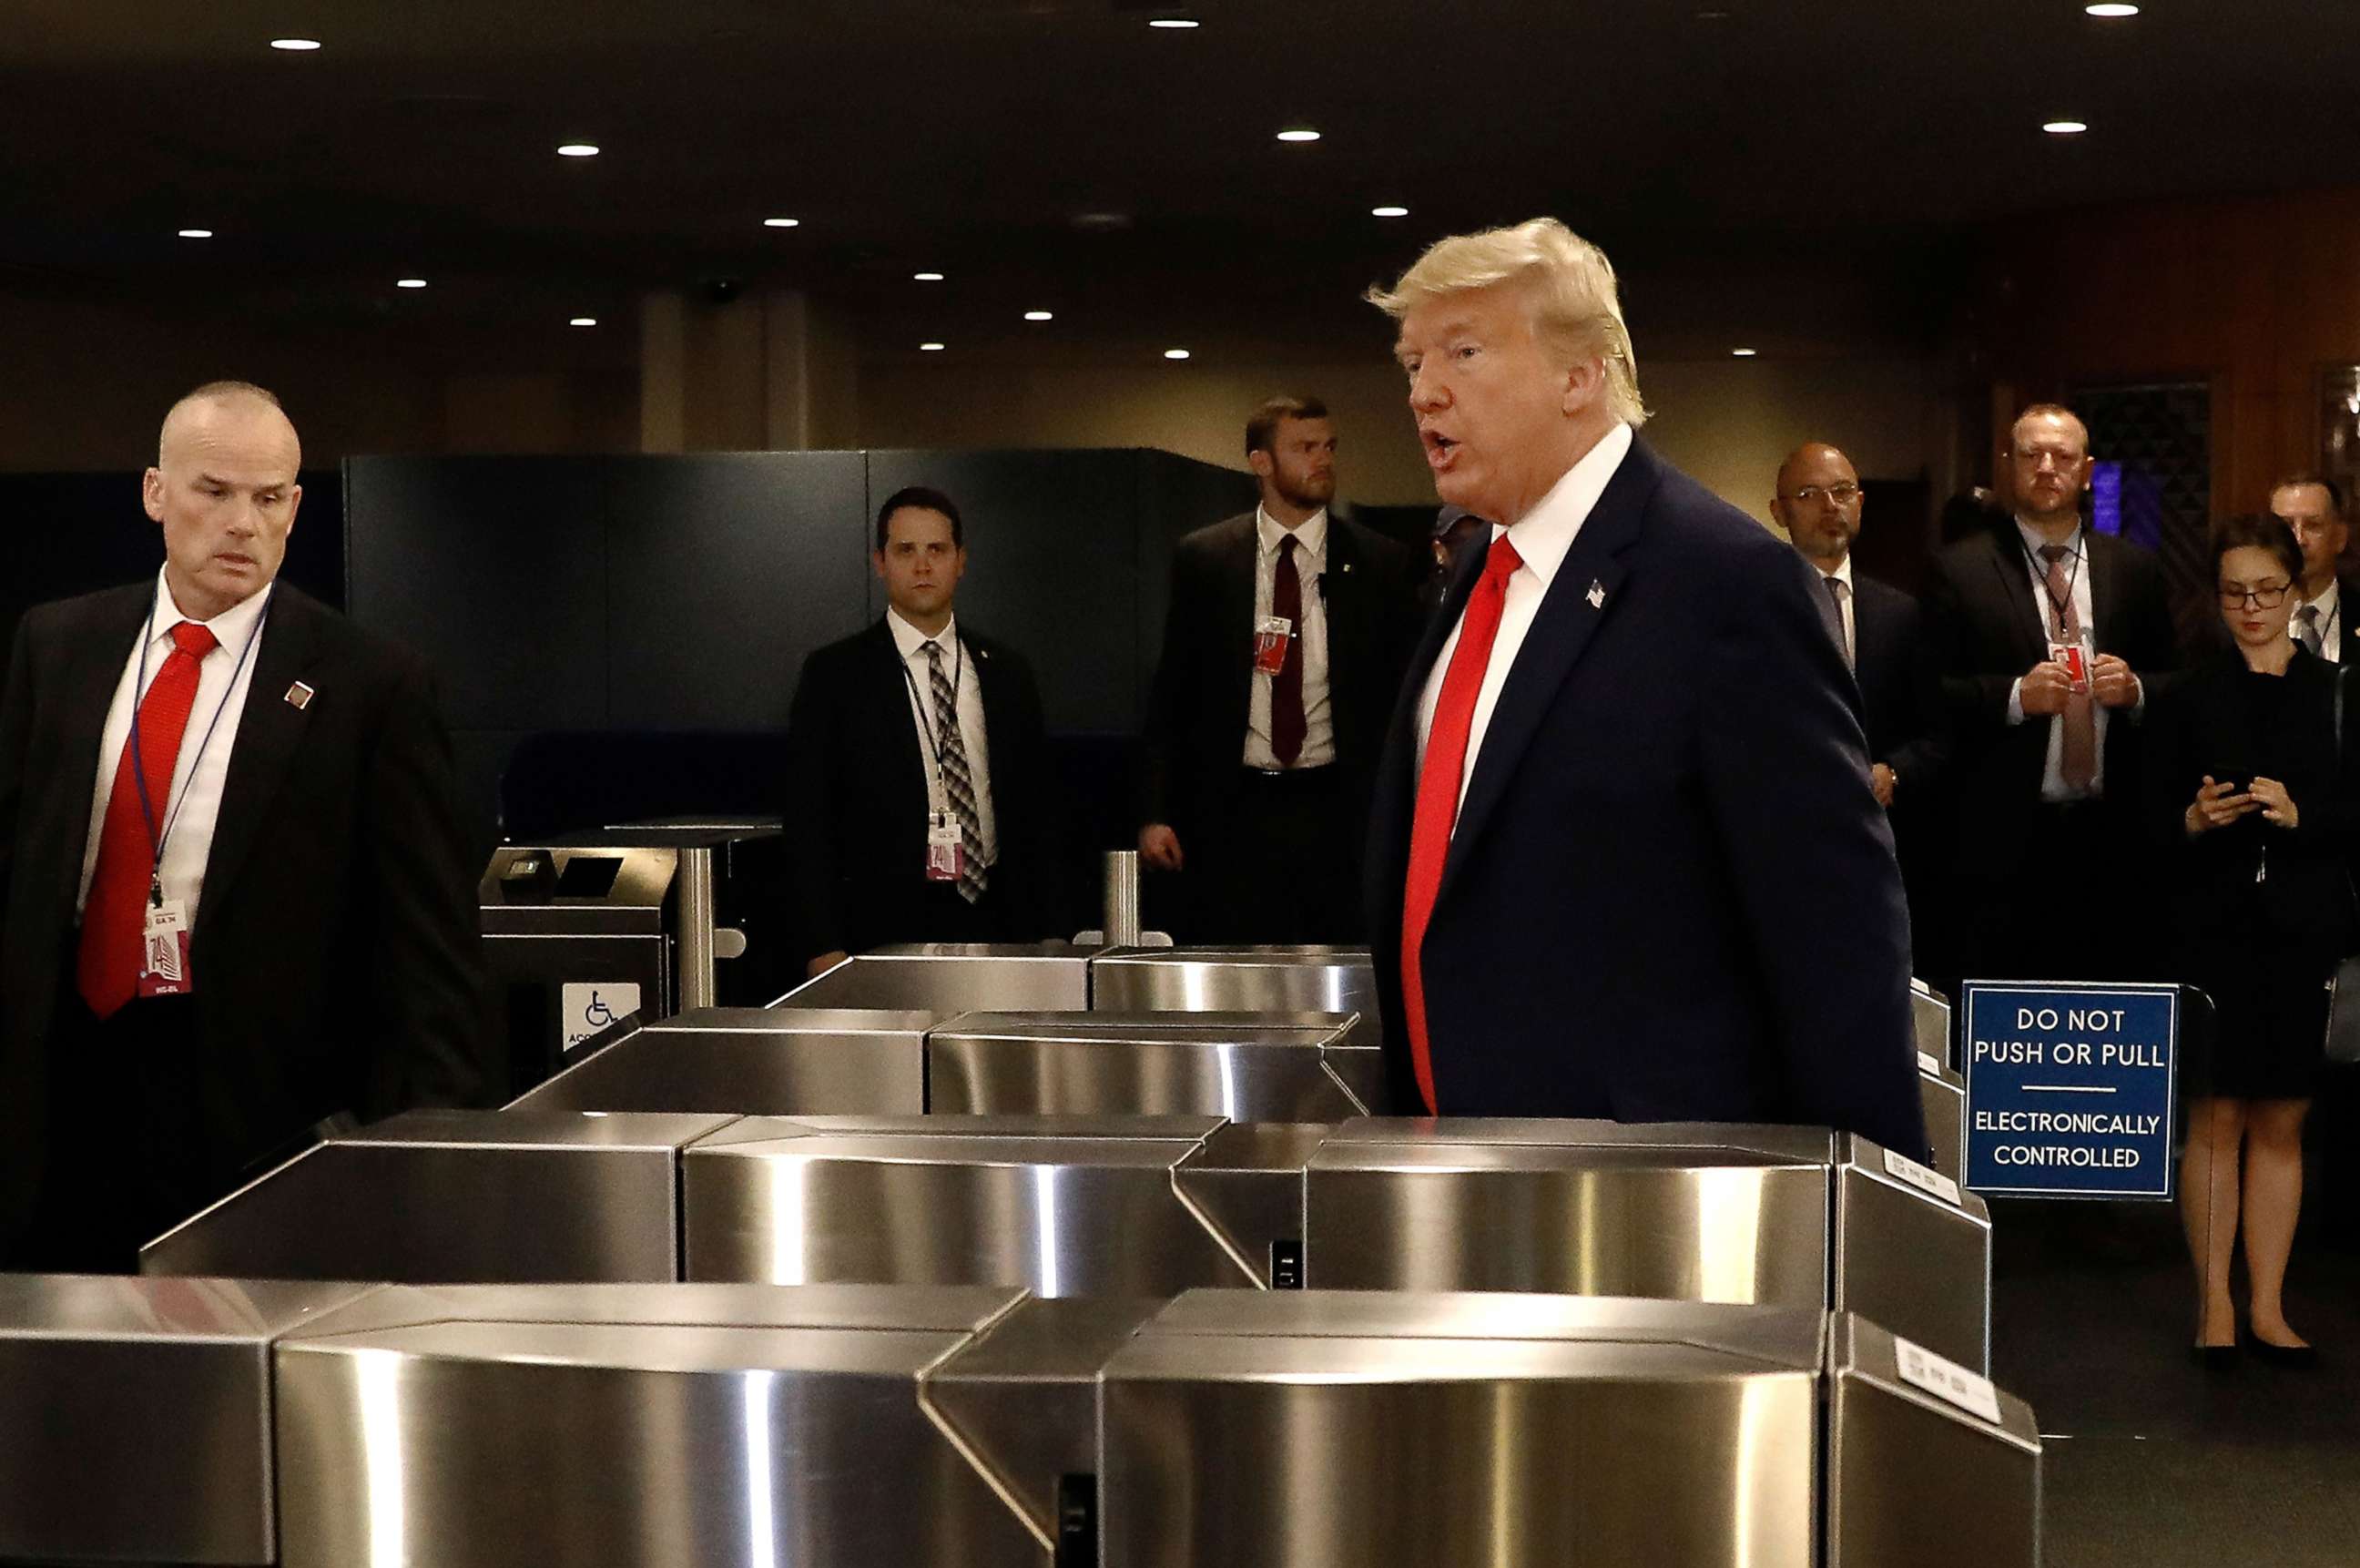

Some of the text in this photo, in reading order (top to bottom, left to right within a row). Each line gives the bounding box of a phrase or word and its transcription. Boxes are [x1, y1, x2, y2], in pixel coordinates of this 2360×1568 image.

[2017, 1008, 2125, 1033] DO NOT
[1974, 1041, 2165, 1067] PUSH OR PULL
[1975, 1111, 2161, 1135] ELECTRONICALLY
[1993, 1145, 2141, 1168] CONTROLLED
